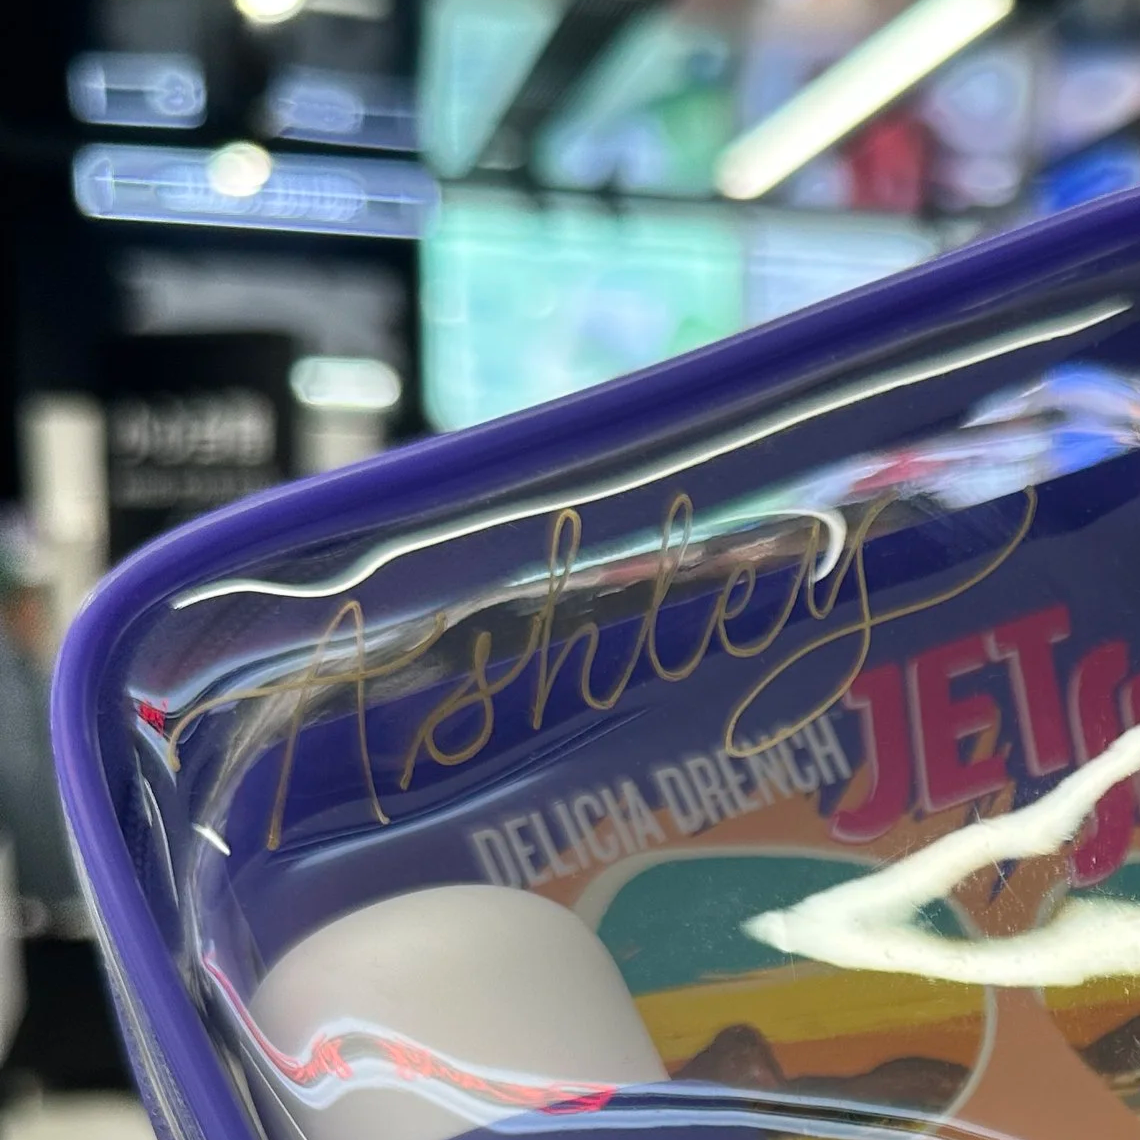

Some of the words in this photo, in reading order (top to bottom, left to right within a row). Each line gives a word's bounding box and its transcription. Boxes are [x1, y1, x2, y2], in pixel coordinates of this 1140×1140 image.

[168, 485, 1035, 850] Ashley
[654, 713, 852, 834] DRENCH
[830, 602, 1071, 843] JET
